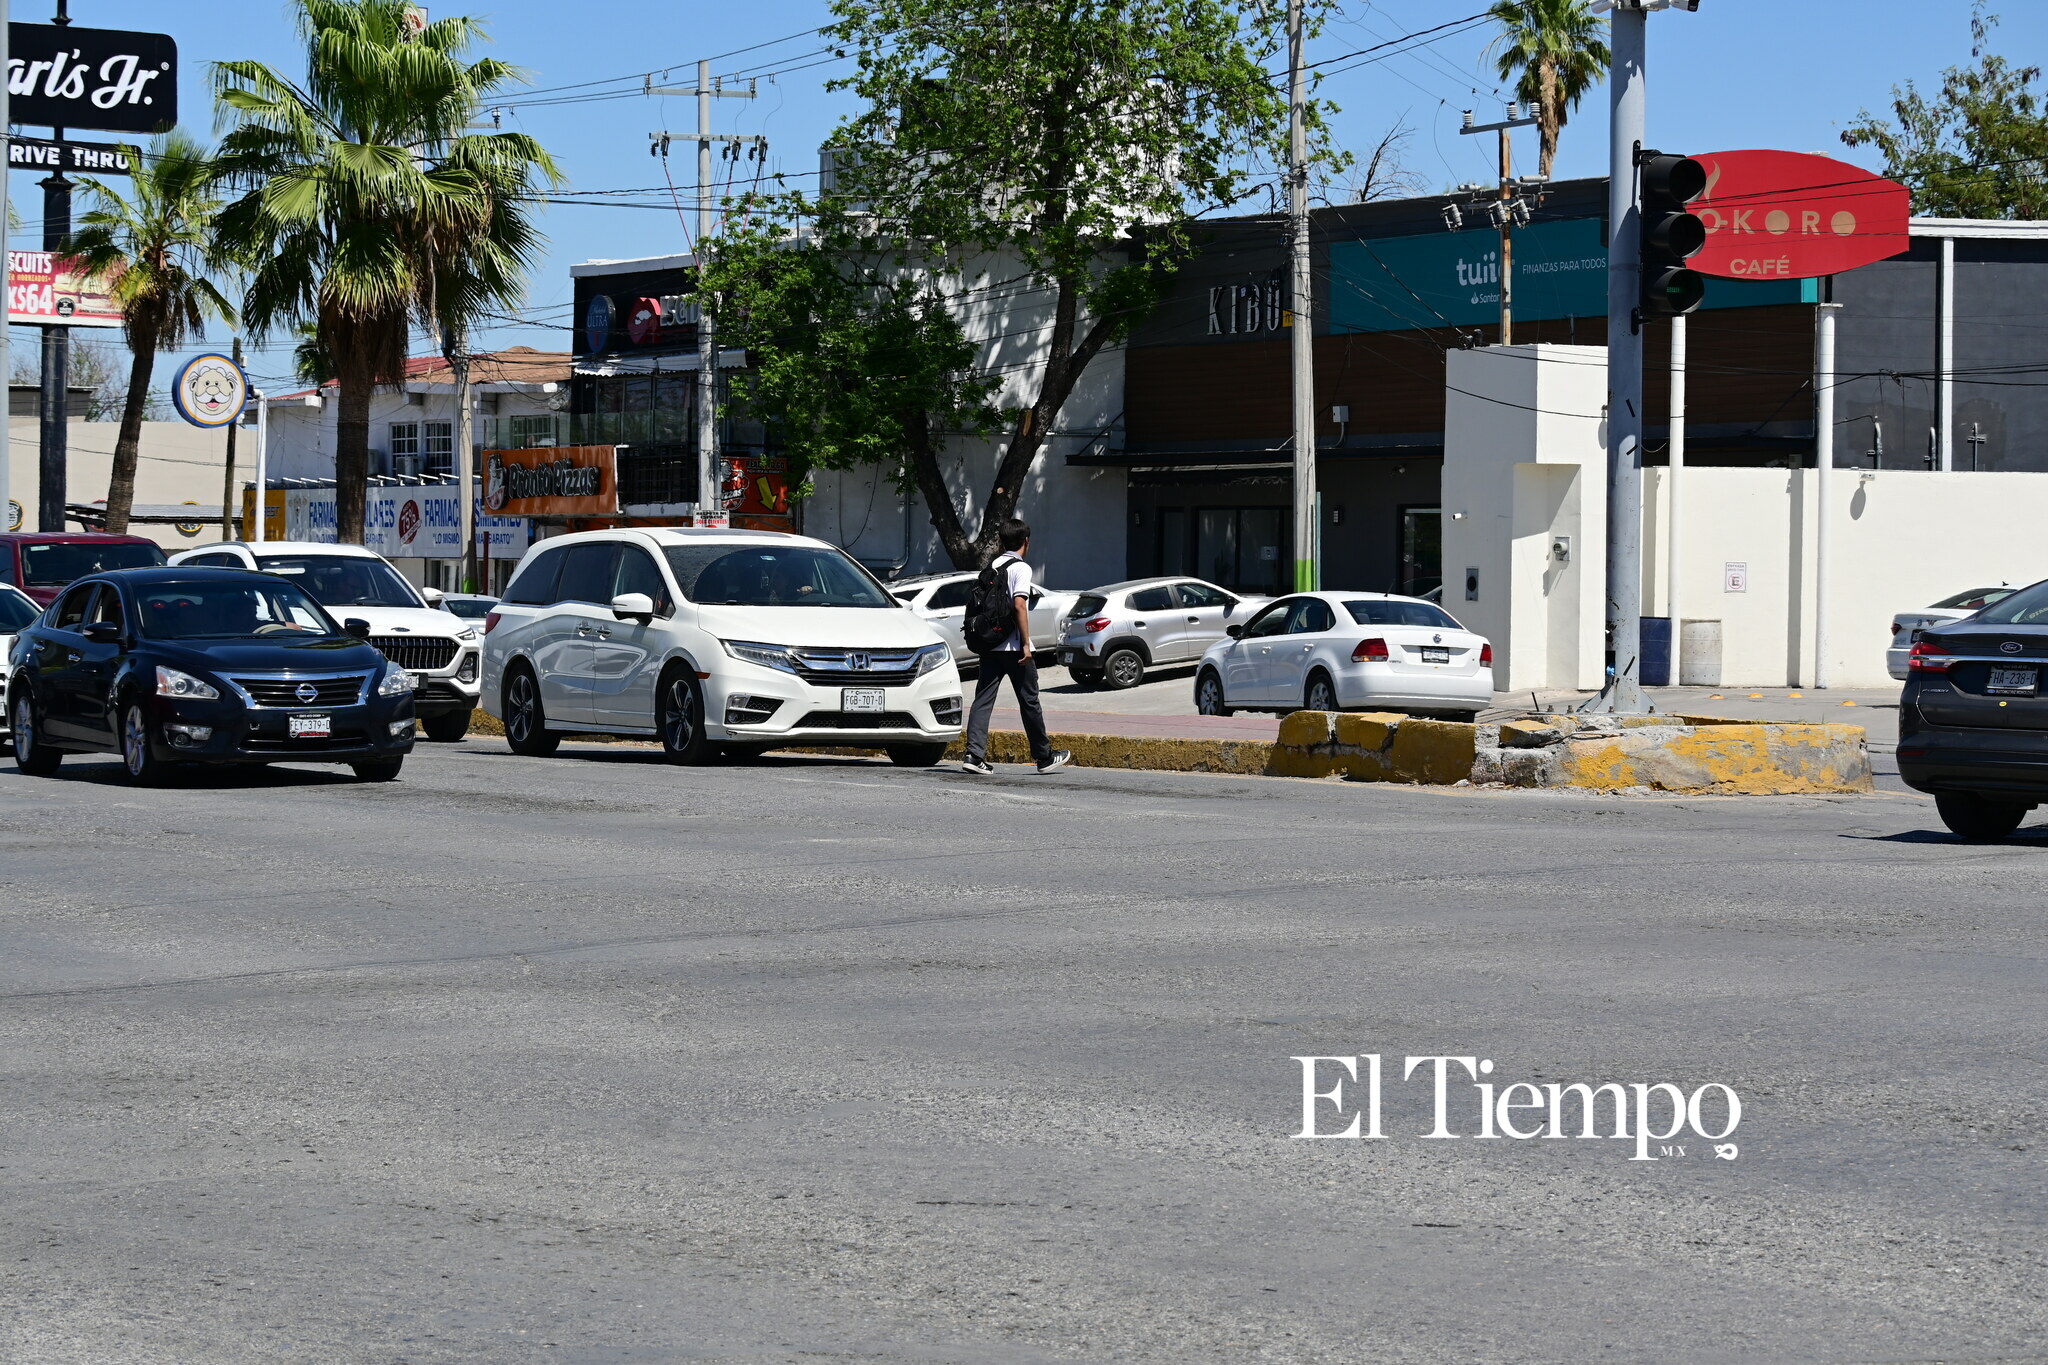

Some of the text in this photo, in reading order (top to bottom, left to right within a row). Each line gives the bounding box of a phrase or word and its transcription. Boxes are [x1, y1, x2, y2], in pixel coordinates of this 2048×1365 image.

[9, 48, 159, 109] arl's Jr.
[9, 145, 129, 169] RIVE THRU
[8, 252, 52, 274] SCUITS
[1456, 251, 1500, 287] tuii
[1523, 257, 1606, 275] FINANZAS PARA TODOS
[1729, 255, 1790, 275] CAFÉ
[8, 284, 53, 314] X$64
[587, 315, 608, 328] ULTRA
[508, 458, 599, 499] Pronto Pizzas
[309, 499, 395, 528] FARMAC ILARES
[425, 498, 461, 528] FARMACI
